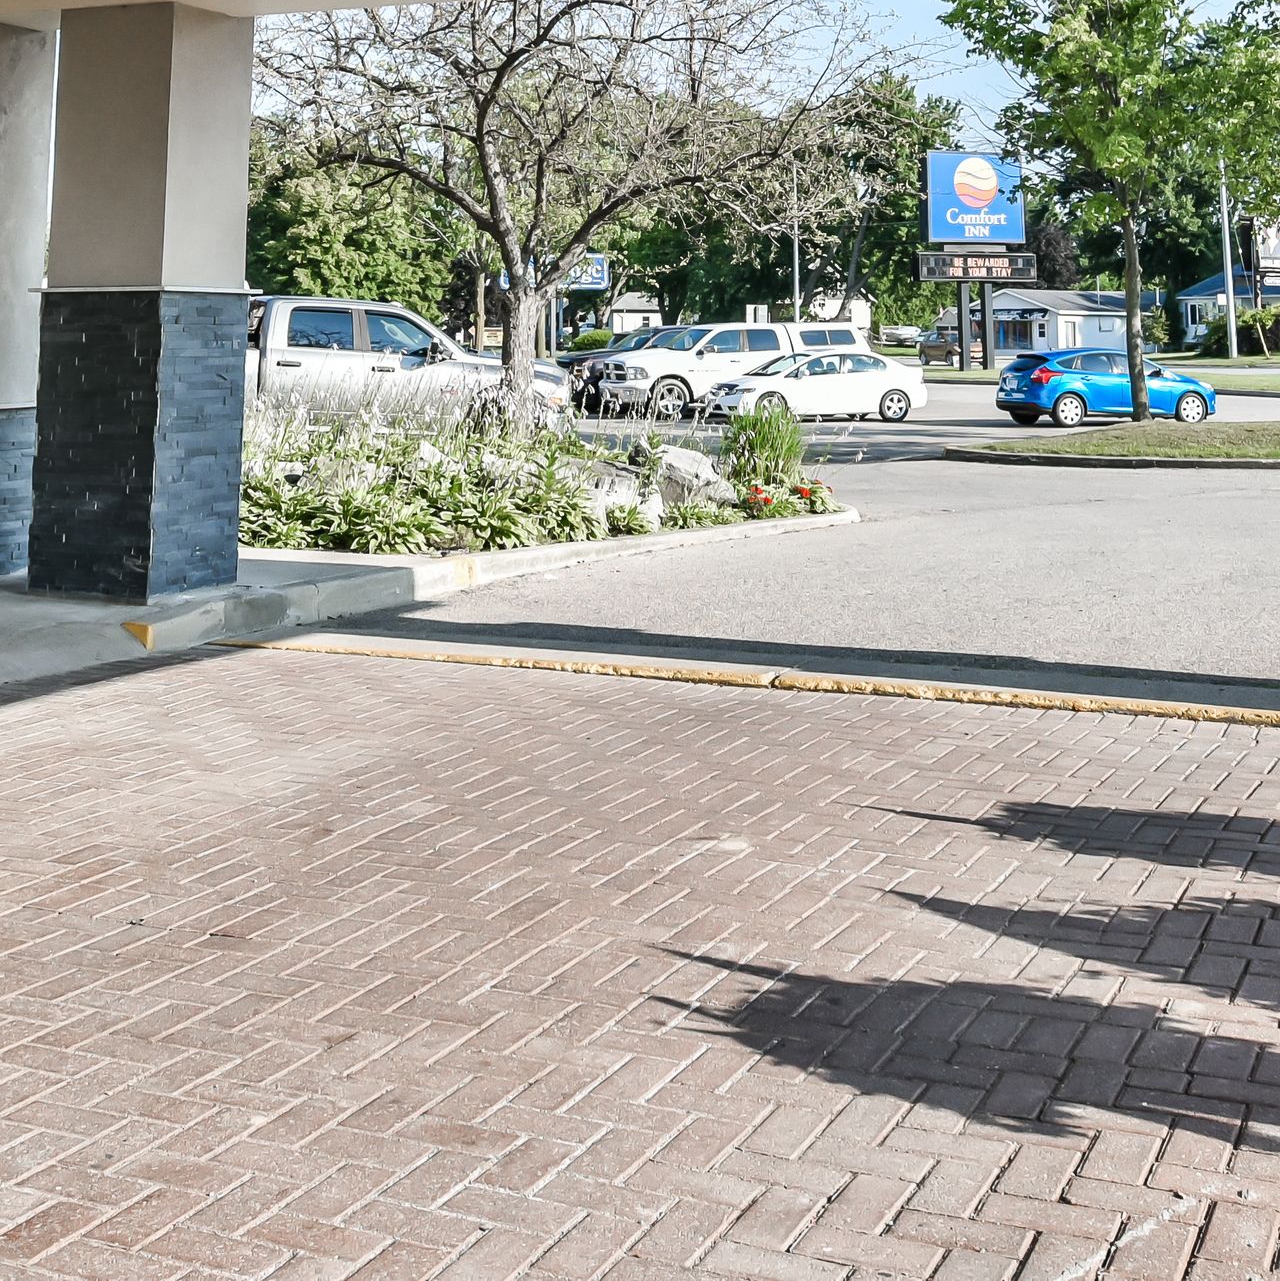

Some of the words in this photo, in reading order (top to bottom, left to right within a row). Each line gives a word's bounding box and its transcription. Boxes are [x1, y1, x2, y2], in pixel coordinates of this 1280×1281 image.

[946, 208, 1007, 225] Comfort
[964, 225, 990, 237] INN
[953, 258, 964, 267] BE
[967, 258, 1009, 267] REWARDED
[949, 268, 963, 277] FOR
[968, 268, 987, 277] YOUR
[992, 268, 1012, 277] STAY
